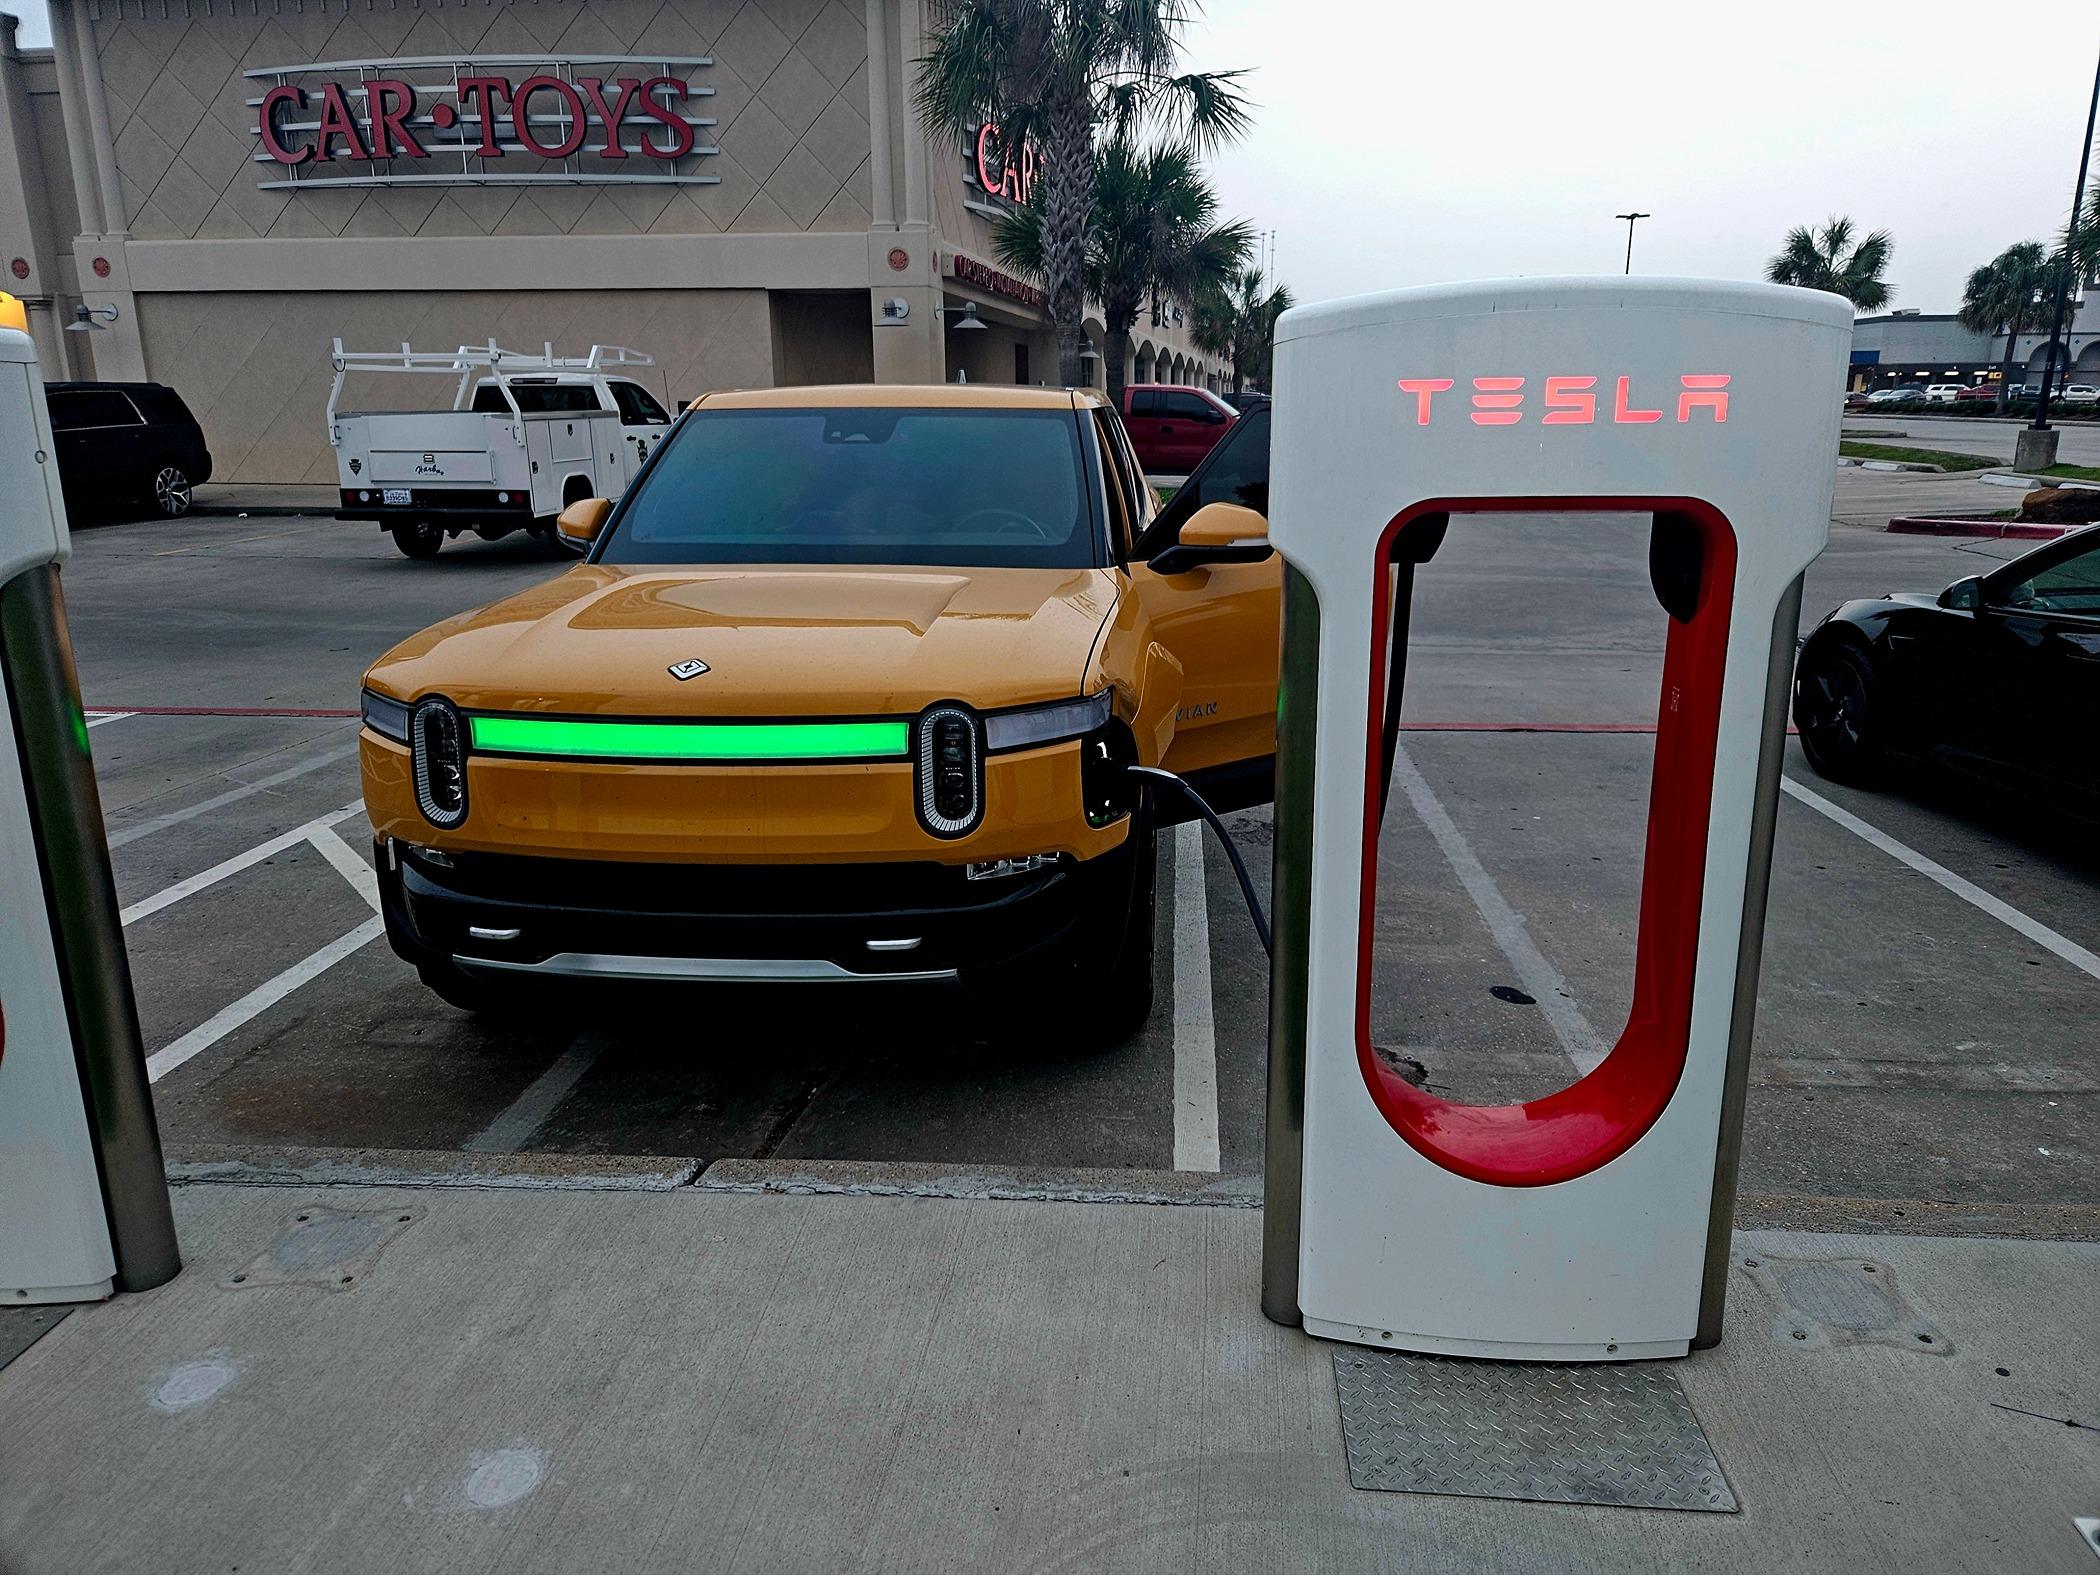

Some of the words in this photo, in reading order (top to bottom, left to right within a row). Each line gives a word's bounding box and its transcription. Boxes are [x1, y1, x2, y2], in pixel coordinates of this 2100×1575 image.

[259, 79, 431, 164] CAR
[458, 75, 695, 160] TOYS
[1397, 374, 1732, 426] TESLA
